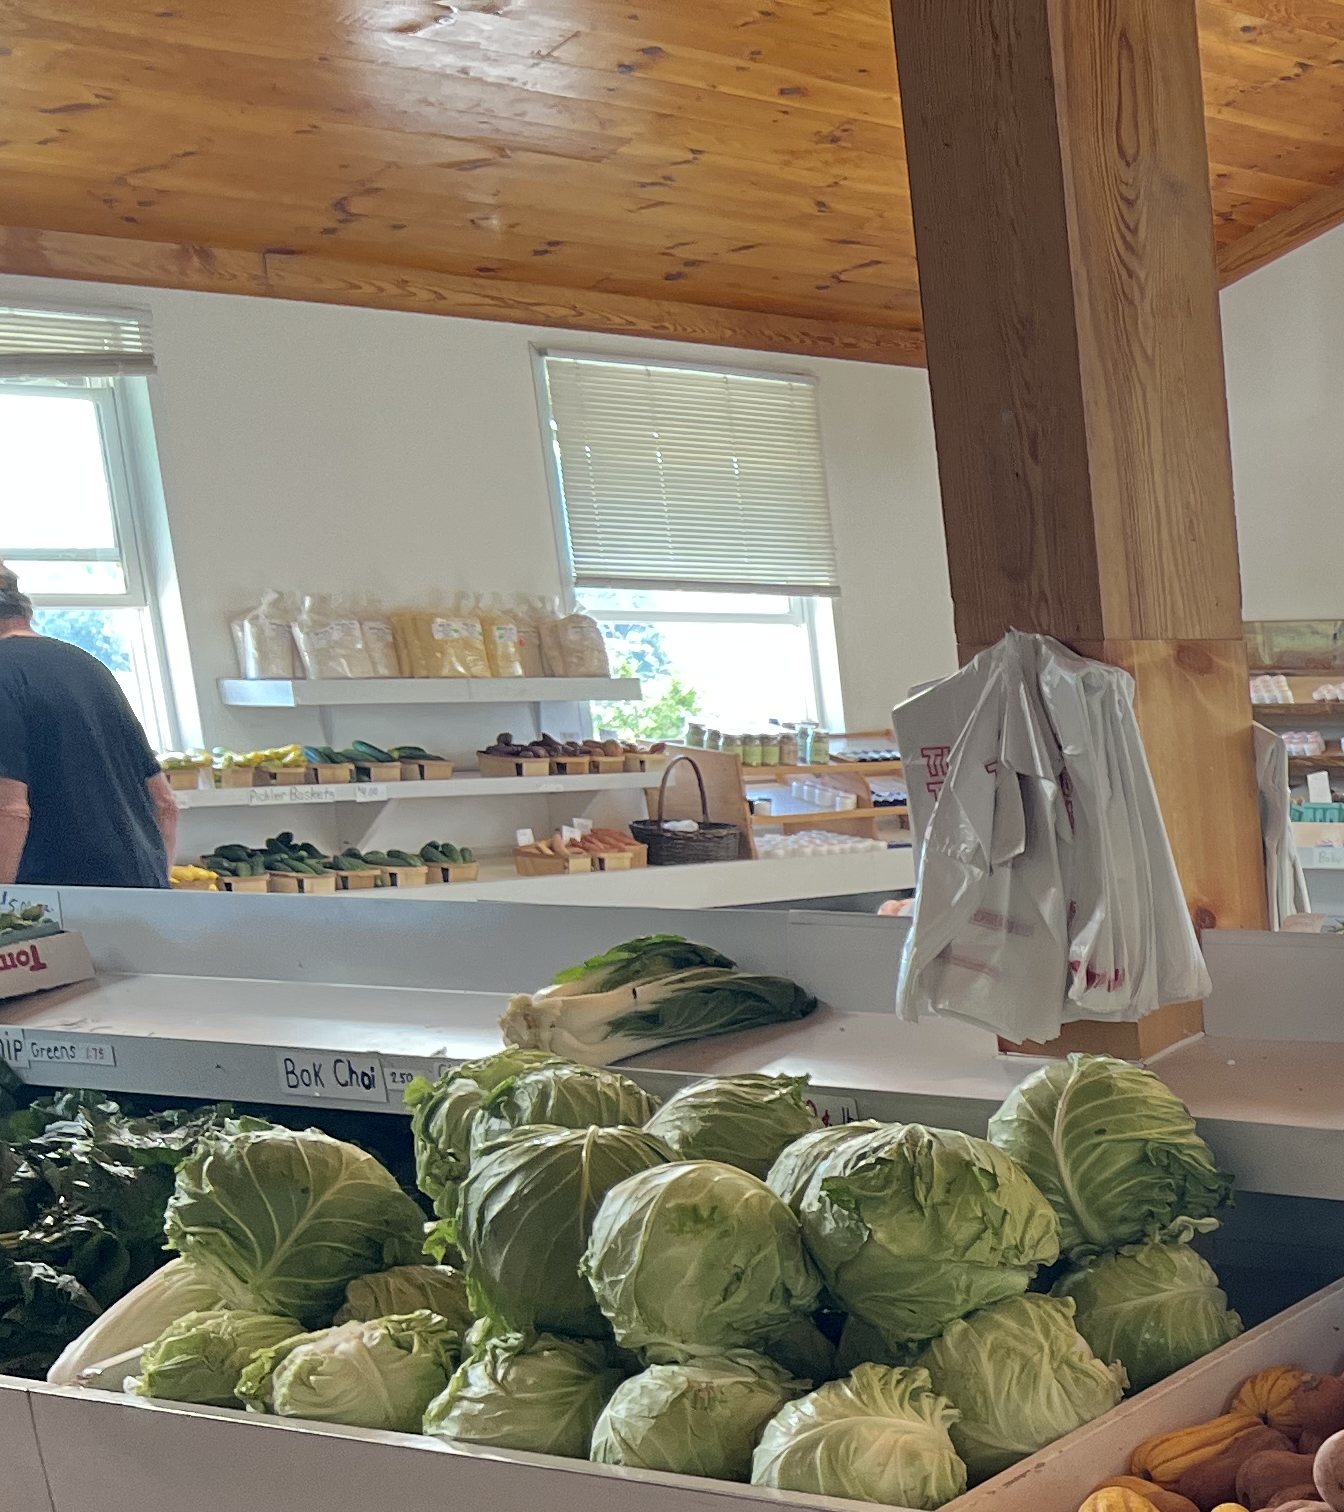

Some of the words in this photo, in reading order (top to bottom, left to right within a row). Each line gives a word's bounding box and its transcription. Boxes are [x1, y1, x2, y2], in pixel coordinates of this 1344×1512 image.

[289, 787, 335, 800] Baskets
[31, 1042, 76, 1060] Greens
[333, 1059, 376, 1090] Choi
